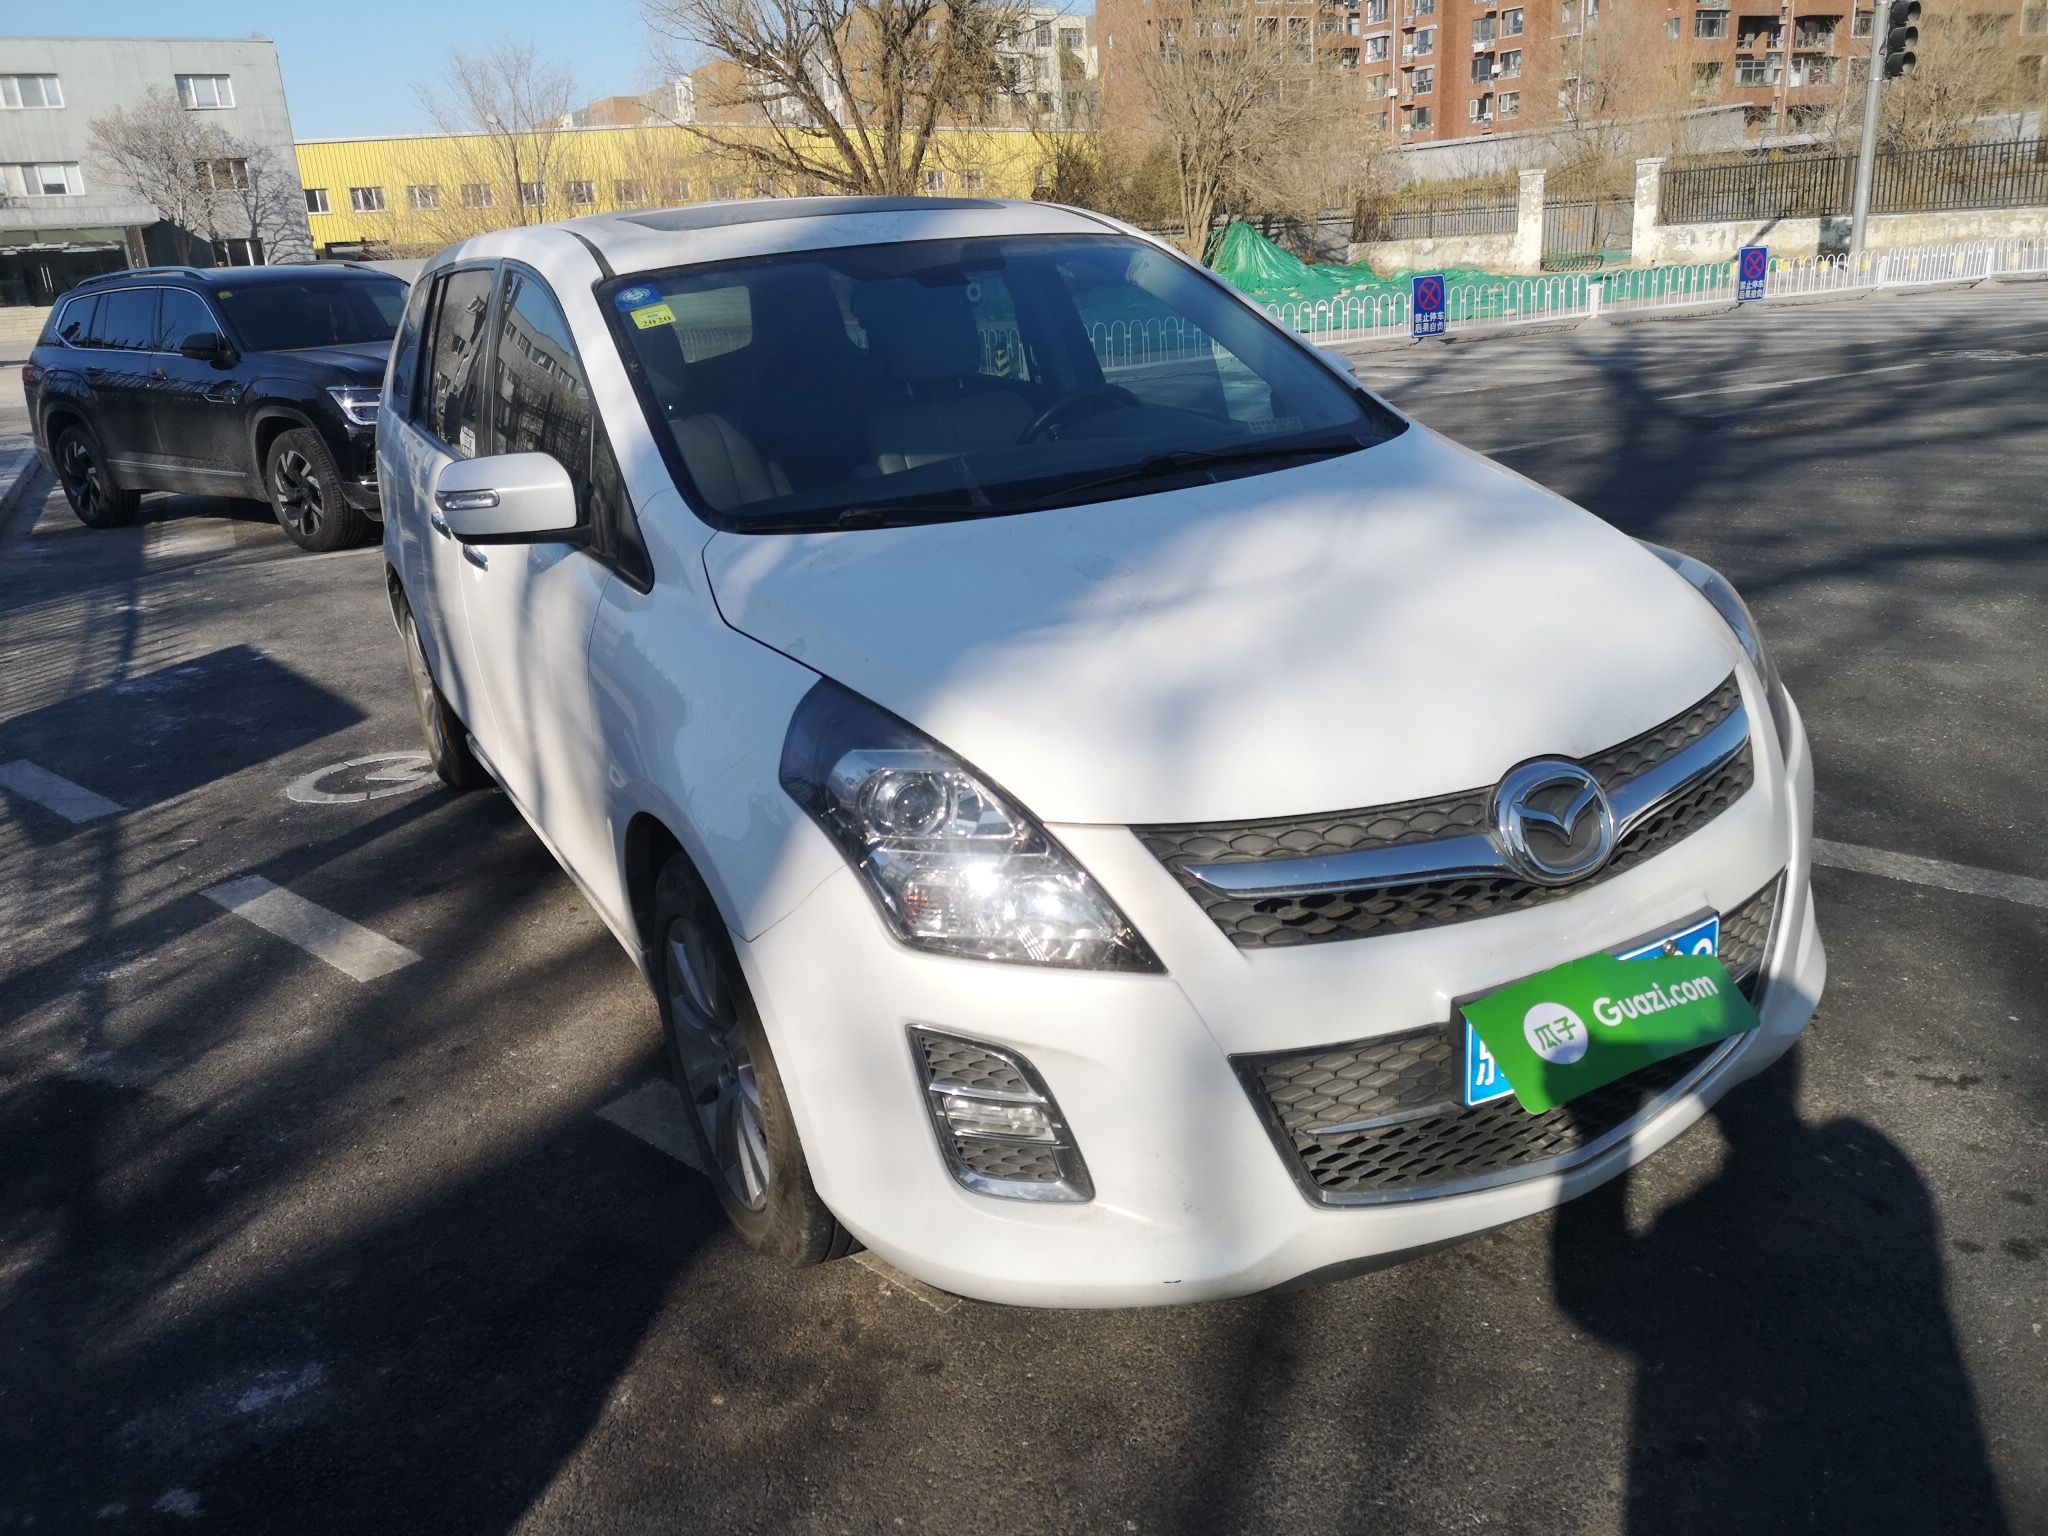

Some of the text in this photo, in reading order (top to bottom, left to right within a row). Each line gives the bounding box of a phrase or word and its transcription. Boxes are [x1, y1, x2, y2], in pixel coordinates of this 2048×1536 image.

[642, 315, 671, 328] 2020
[1415, 311, 1444, 323] 禁止停车
[1415, 321, 1443, 334] 后果自负
[1593, 975, 1719, 1027] Guazi.com
[1533, 1016, 1576, 1051] 瓜子
